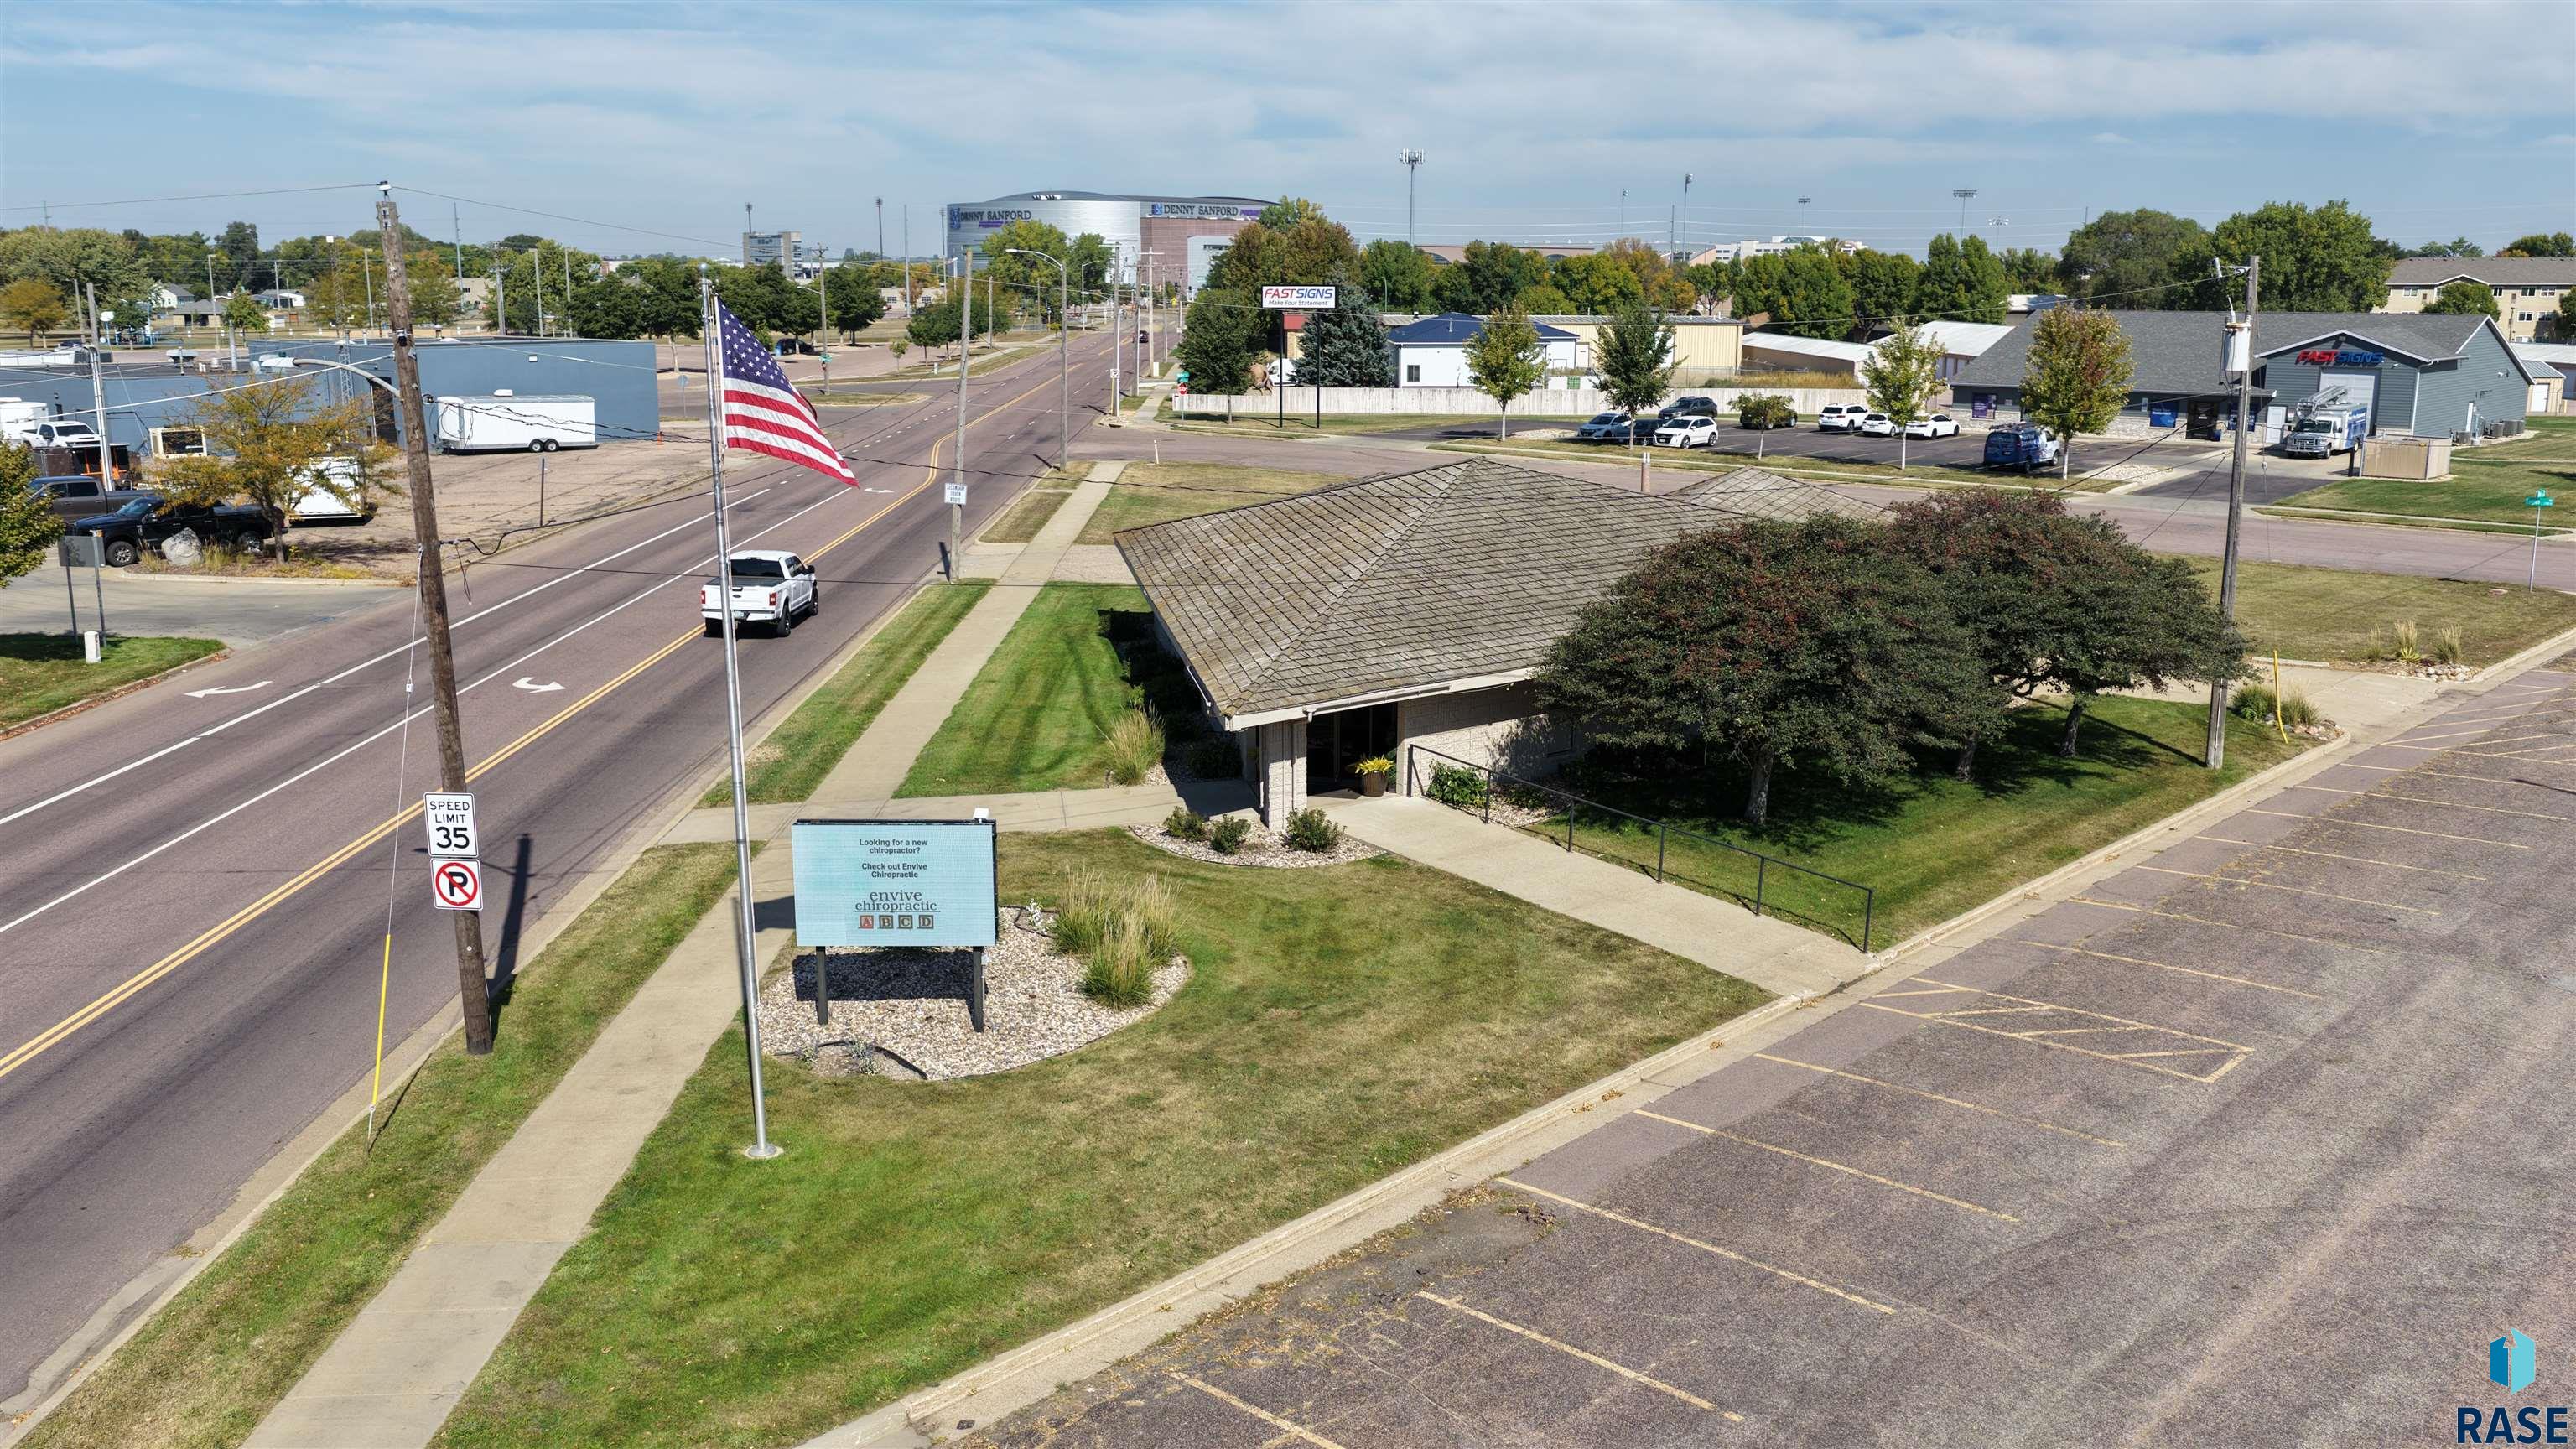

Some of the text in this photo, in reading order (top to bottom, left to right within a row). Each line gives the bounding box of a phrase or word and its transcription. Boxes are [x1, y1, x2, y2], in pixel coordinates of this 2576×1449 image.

[986, 210, 1032, 221] SANFORD
[1163, 204, 1196, 215] DENNY
[1197, 205, 1239, 216] SANFORD
[1264, 288, 1334, 299] FASTSIGNS
[2296, 349, 2384, 365] FASTSIGNS
[429, 800, 470, 811] SPEED
[434, 813, 466, 823] LIMIT
[435, 826, 470, 849] 35
[859, 839, 891, 847] Looking
[869, 846, 921, 855] chiropractor?
[870, 870, 918, 879] Chiropractic
[869, 889, 923, 901] envive
[854, 900, 938, 913] chiropractic
